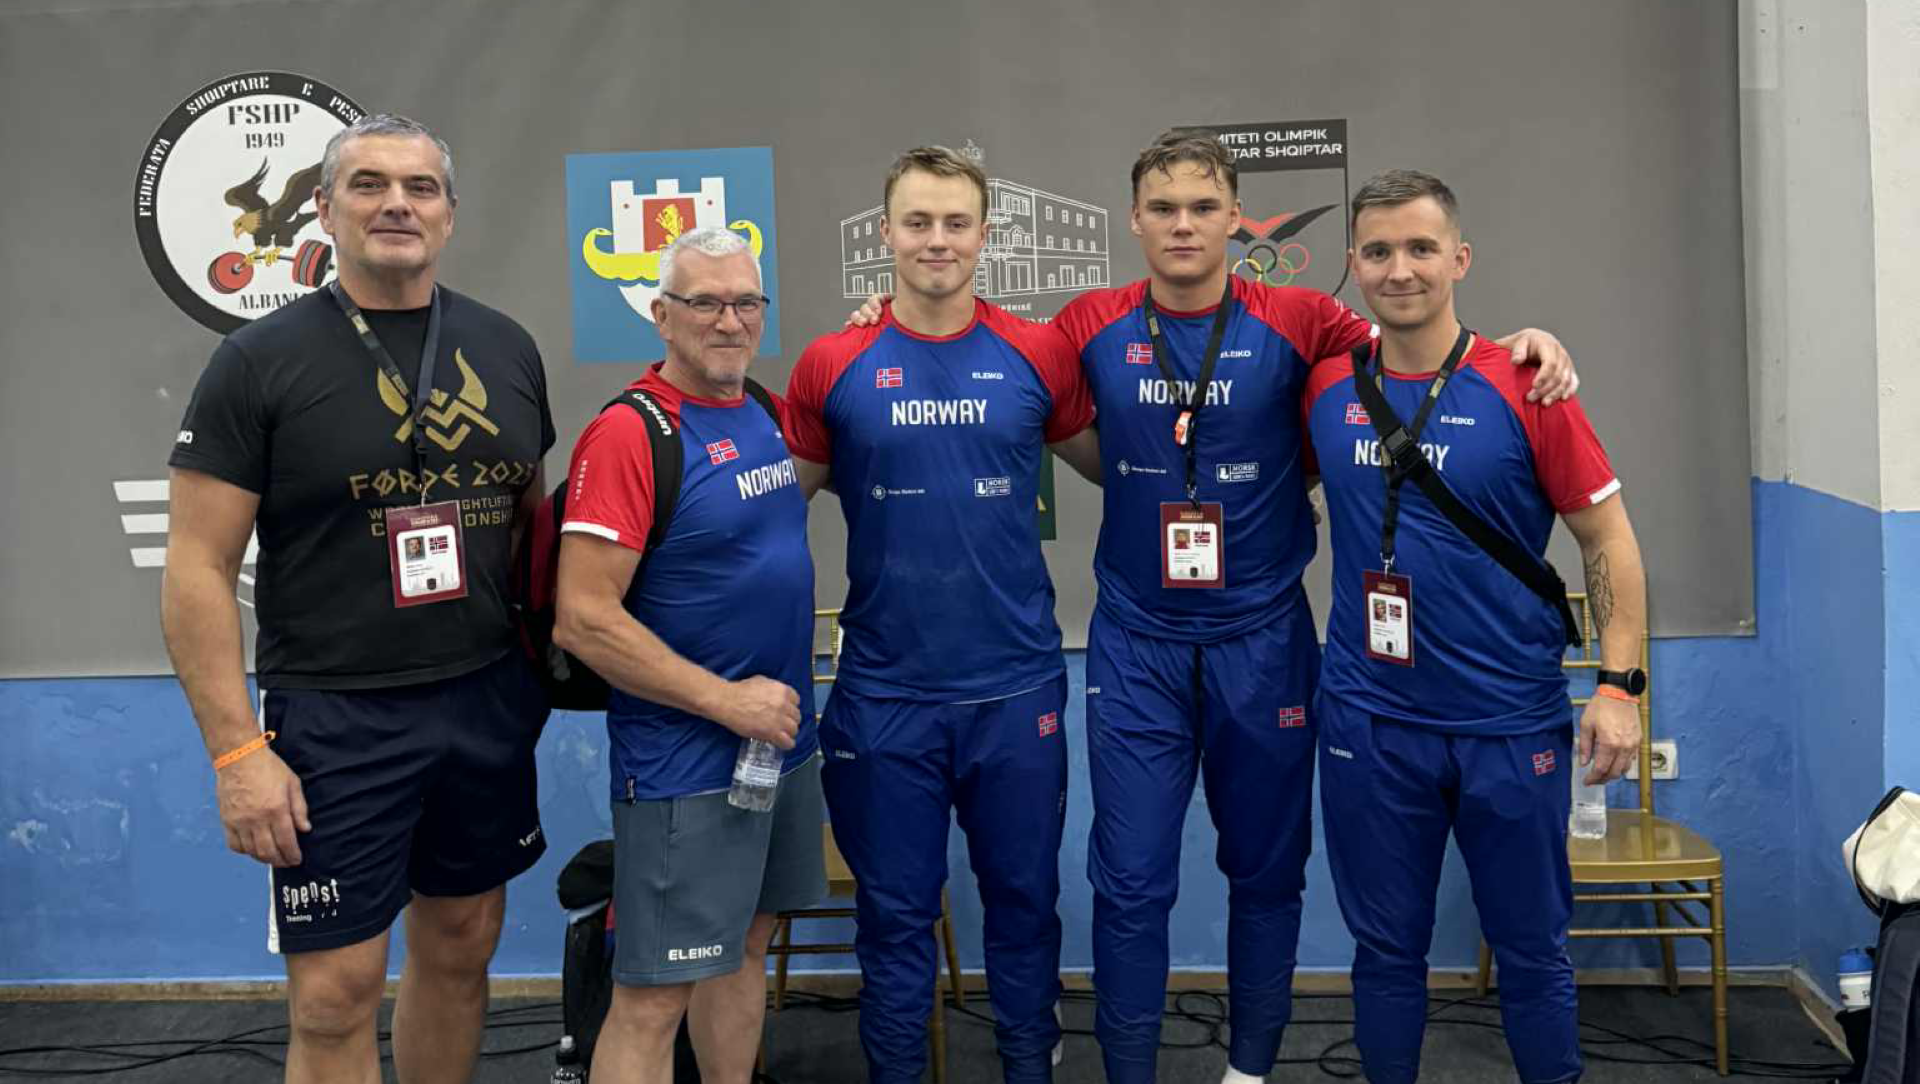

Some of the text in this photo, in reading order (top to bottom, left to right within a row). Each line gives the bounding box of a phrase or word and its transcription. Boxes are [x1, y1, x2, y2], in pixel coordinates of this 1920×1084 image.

[228, 103, 300, 125] FSHP
[246, 133, 284, 149] 1949
[1264, 128, 1328, 142] OLIMPIK
[139, 76, 362, 216] FEDERATA SHQIPTARE E PES
[1230, 143, 1343, 159] TAR SHQIPTAR
[239, 293, 307, 309] ALBAN
[891, 399, 987, 426] NORWAY
[668, 944, 723, 961] ELEIKO
